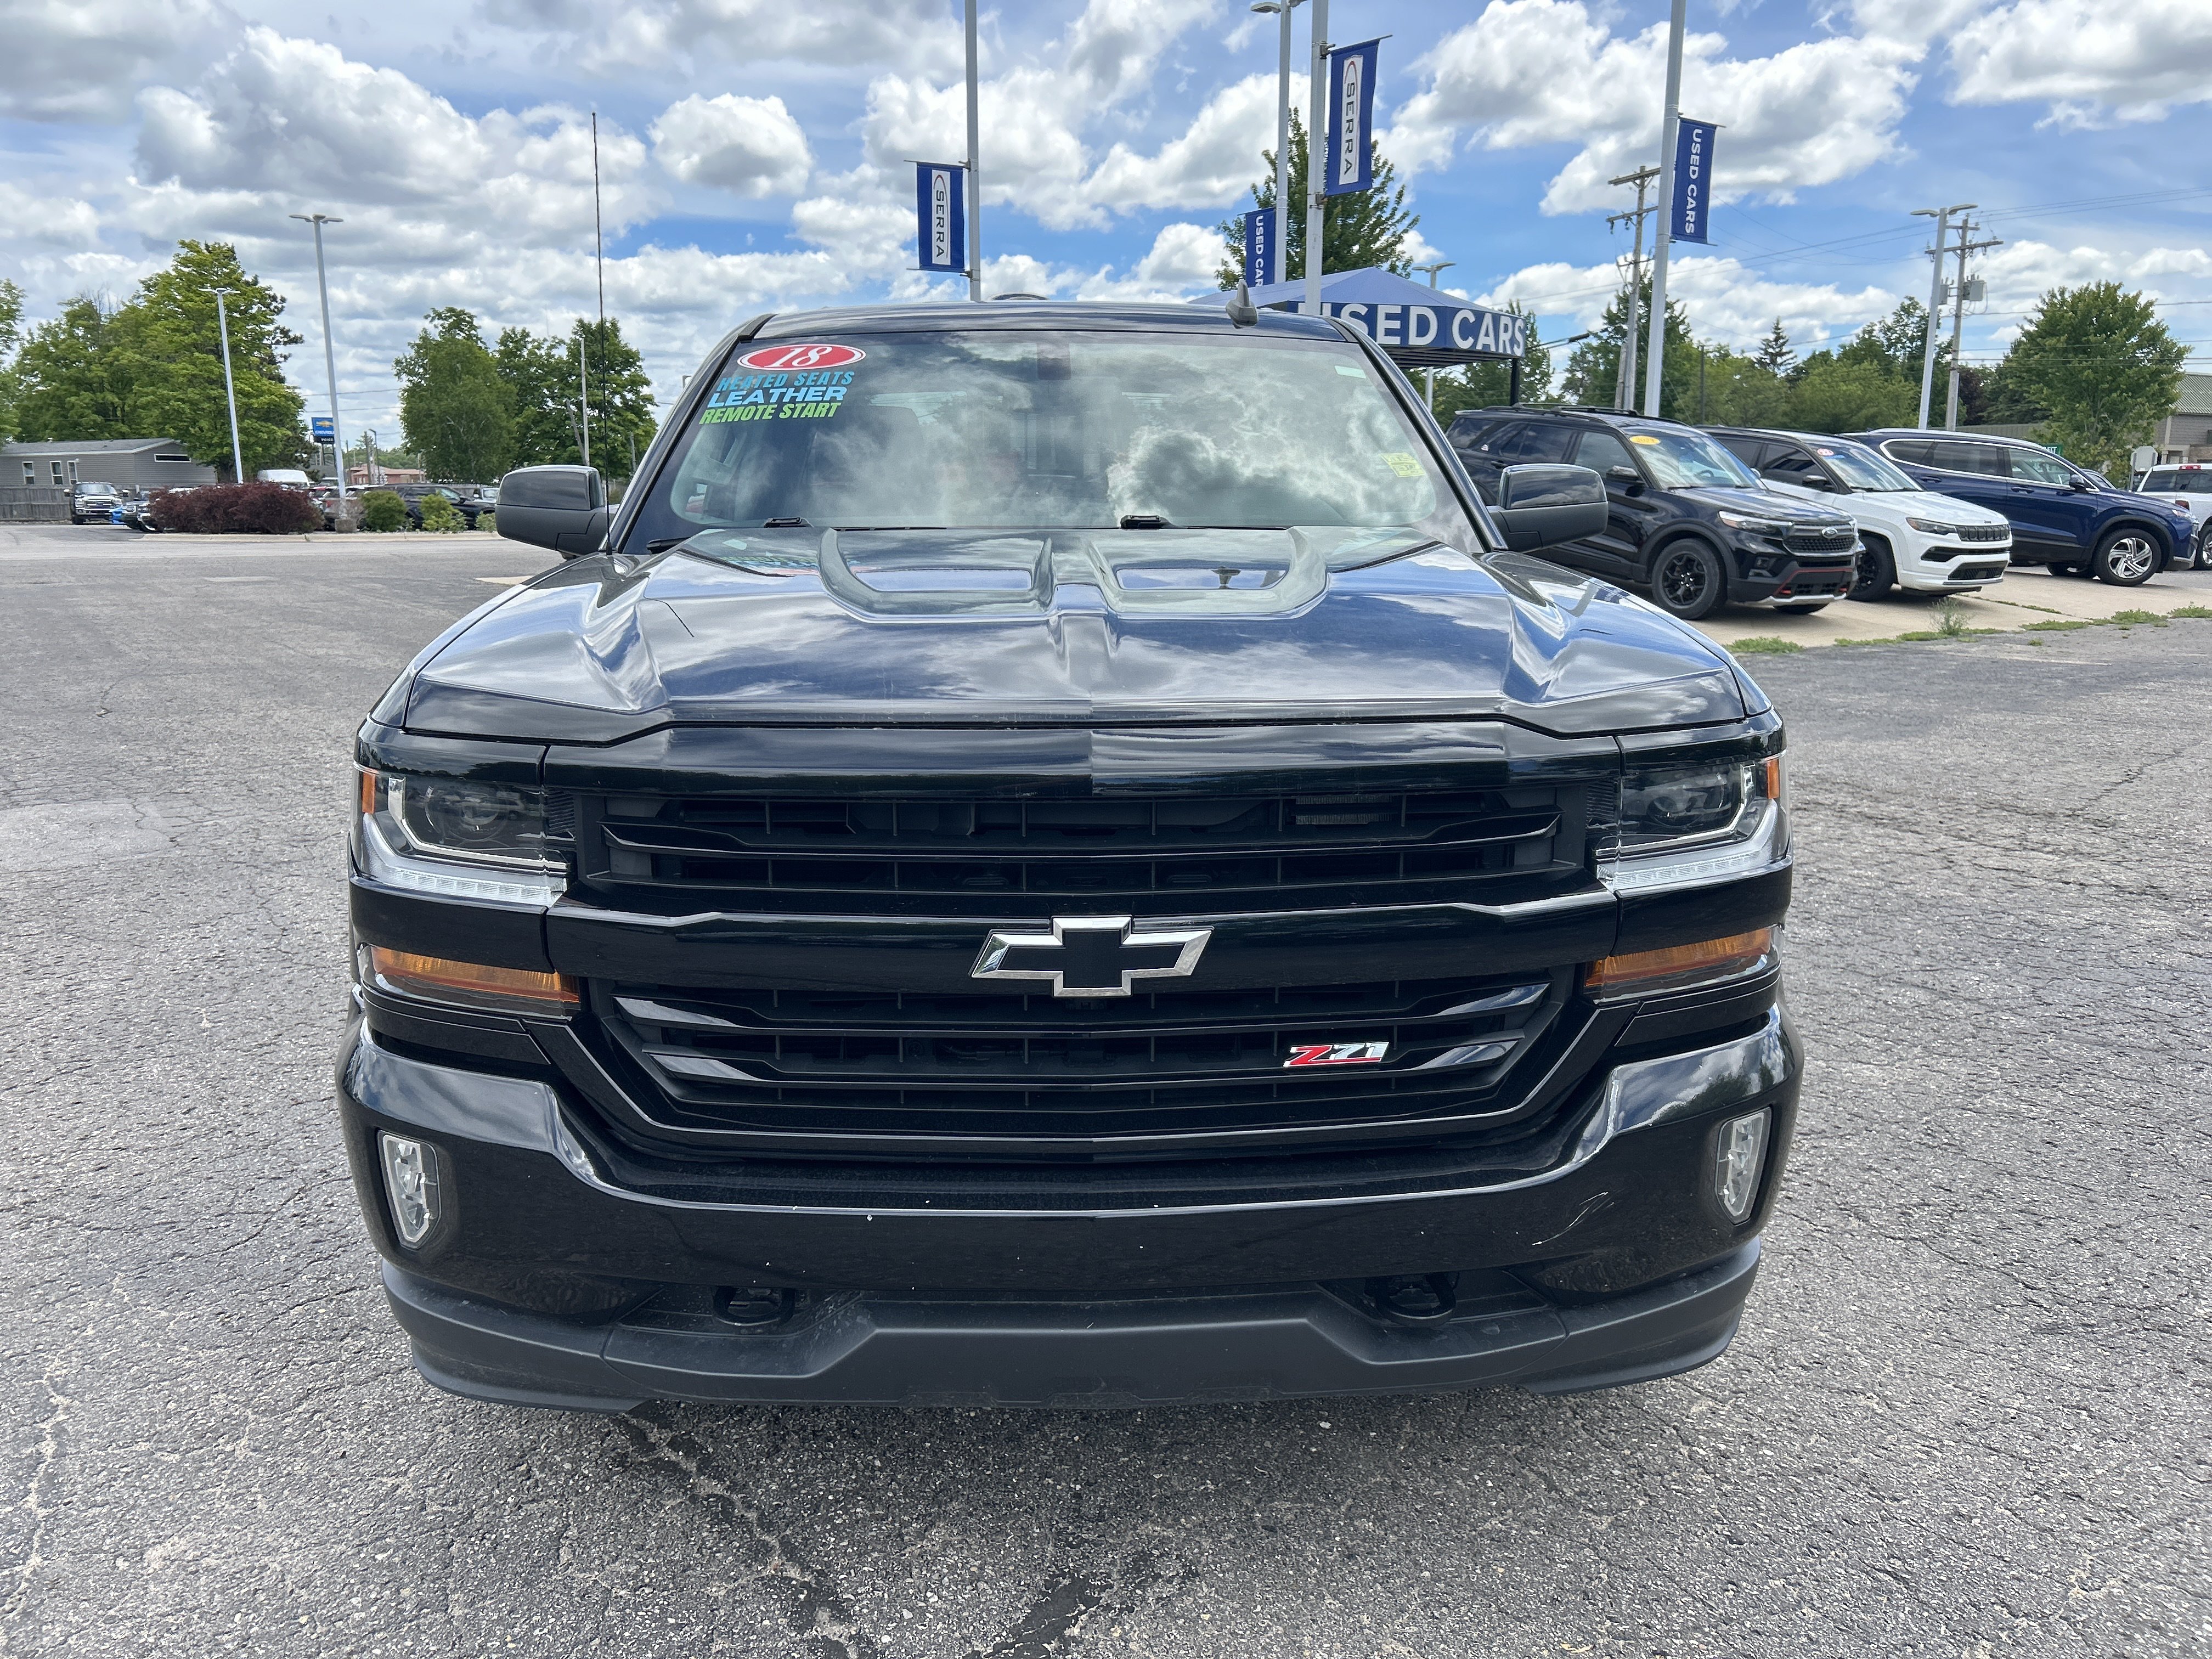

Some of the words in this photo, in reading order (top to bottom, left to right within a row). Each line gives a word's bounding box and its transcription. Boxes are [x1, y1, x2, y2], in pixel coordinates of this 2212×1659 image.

[1344, 82, 1356, 175] SERRA
[1689, 128, 1702, 179] USED
[936, 190, 945, 258] SERRA
[1685, 184, 1697, 234] CARS
[1255, 216, 1264, 255] USED
[1255, 258, 1264, 287] CAR
[1297, 302, 1438, 346] SED
[1452, 309, 1524, 357] CARS
[764, 346, 833, 368] 18
[707, 386, 848, 408] LEATHER
[716, 373, 789, 392] HEATED
[793, 371, 855, 387] SEATS
[698, 404, 778, 425] REMOTE
[778, 402, 842, 419] START
[1283, 1041, 1390, 1067] Z71
